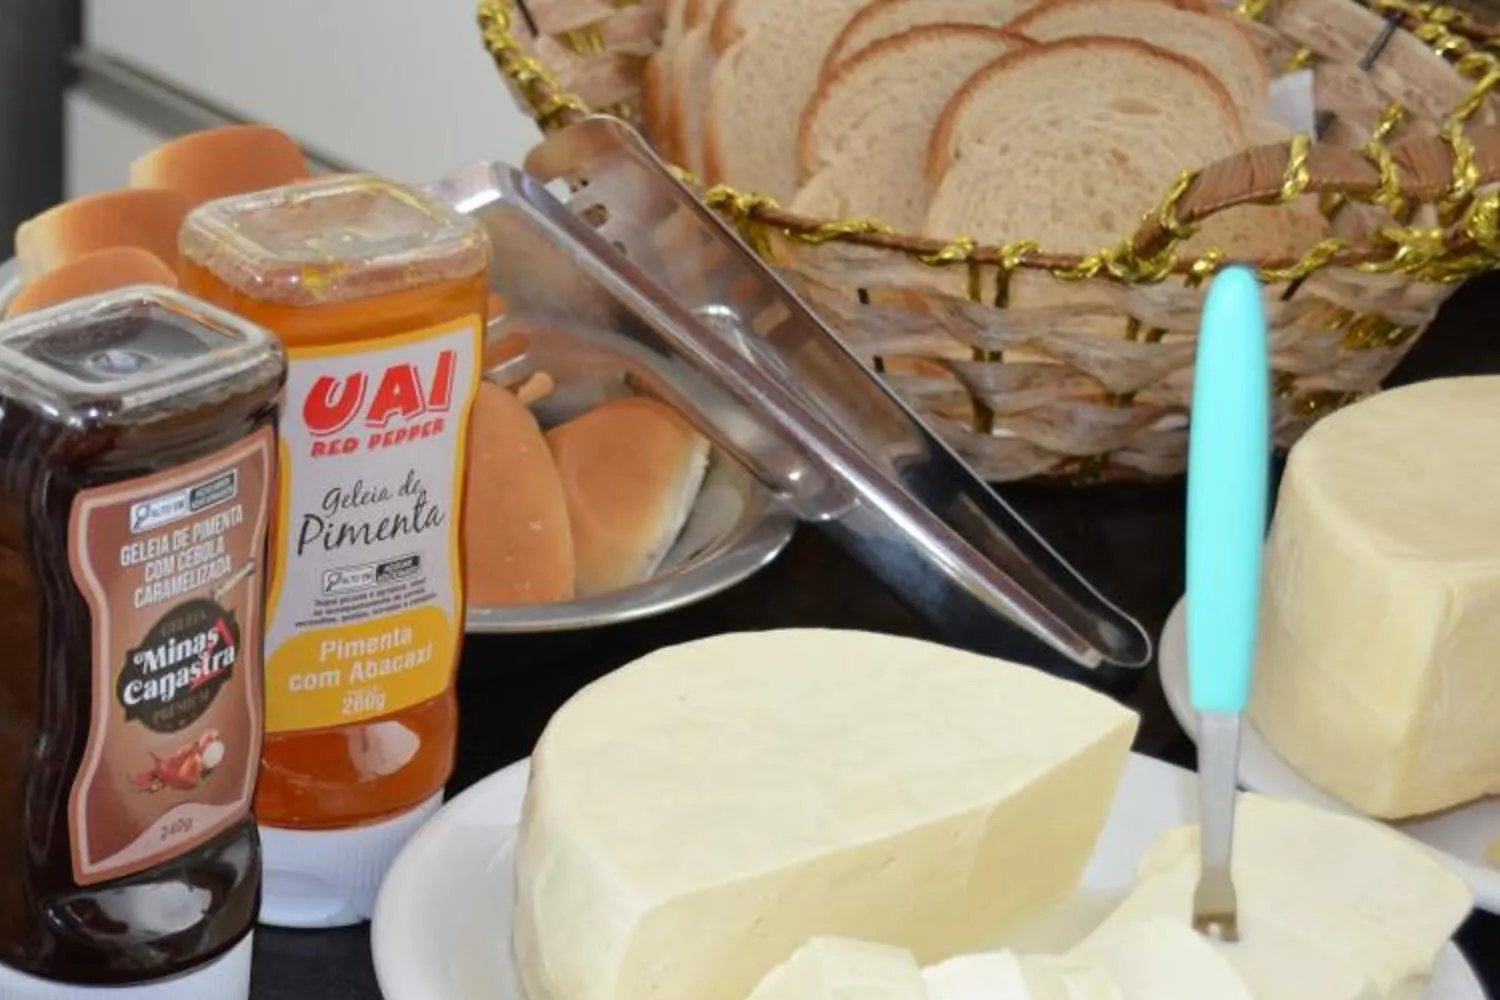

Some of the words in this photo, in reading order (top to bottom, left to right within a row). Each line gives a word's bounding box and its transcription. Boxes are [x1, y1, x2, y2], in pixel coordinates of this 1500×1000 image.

[303, 350, 457, 436] UAI
[311, 438, 360, 457] RED
[367, 418, 445, 449] PEPPER
[397, 468, 424, 496] de
[120, 533, 169, 566] GELEIA
[172, 526, 191, 550] DE
[193, 504, 243, 543] PIMENTA
[297, 490, 445, 556] Pimenta
[134, 553, 232, 609] CARAMELIZADA
[145, 555, 175, 583] COM
[177, 536, 225, 572] CEBOLA
[133, 627, 219, 674] Minas
[289, 670, 341, 692] com
[350, 641, 433, 684] Abacaxi
[320, 625, 413, 662] Pimenta
